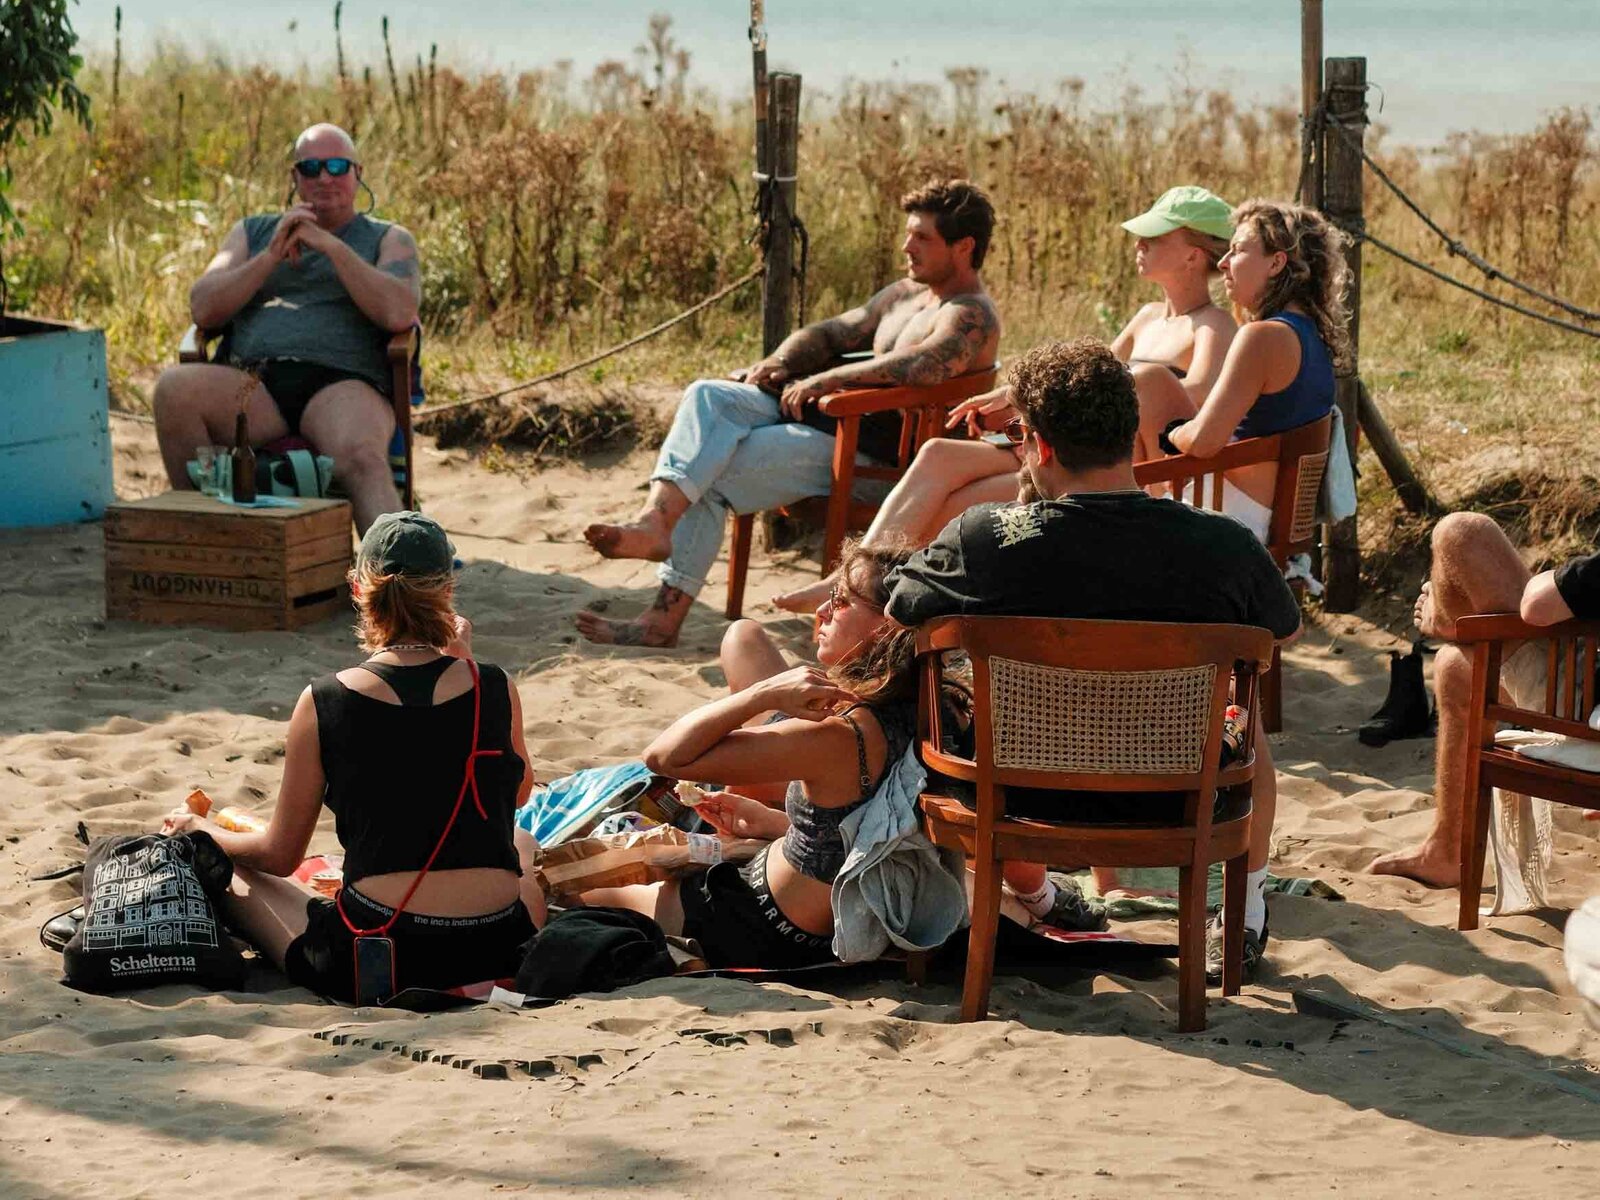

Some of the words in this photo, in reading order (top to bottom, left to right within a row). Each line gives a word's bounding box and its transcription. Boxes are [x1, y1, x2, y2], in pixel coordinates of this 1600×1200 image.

[413, 916, 428, 925] the
[756, 893, 830, 947] ARMOU
[109, 953, 196, 972] Scheltema
